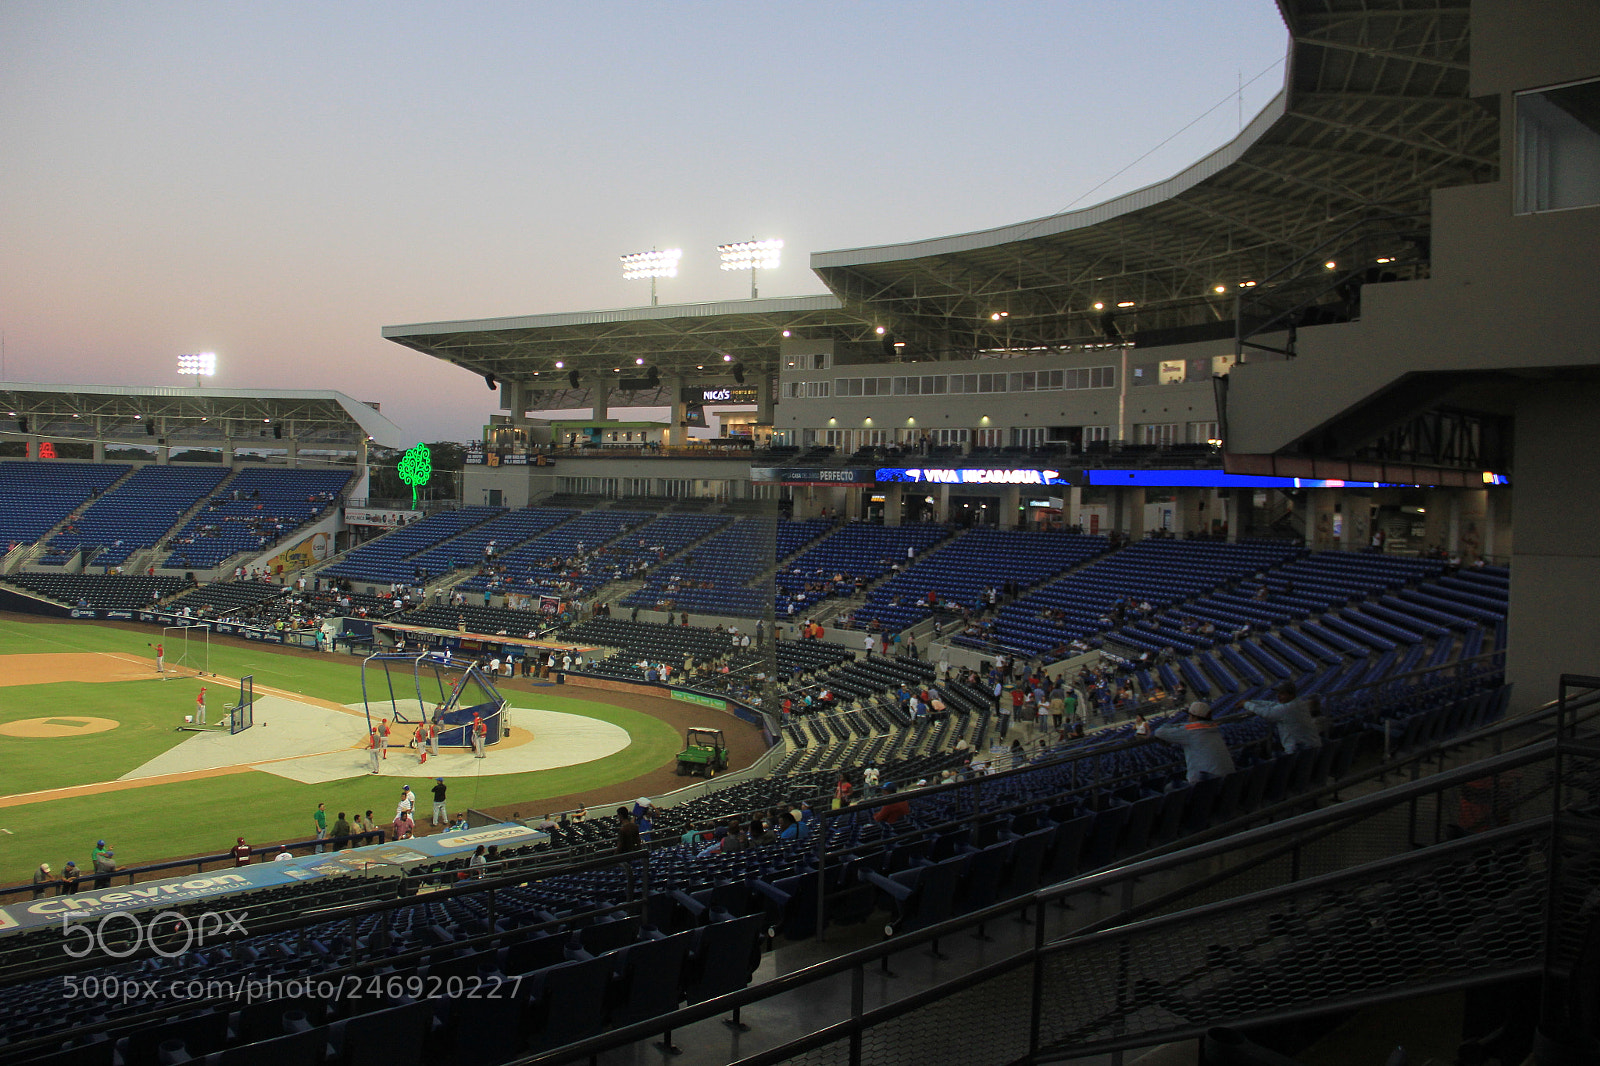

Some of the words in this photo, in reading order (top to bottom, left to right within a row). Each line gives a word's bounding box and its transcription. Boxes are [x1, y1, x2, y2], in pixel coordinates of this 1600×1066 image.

[703, 389, 730, 400] NICA'S
[820, 471, 853, 480] PERFECTO
[924, 469, 959, 483] VIVA
[962, 469, 1041, 483] NICARAGUA
[27, 873, 247, 914] Chevron
[45, 895, 172, 920] LUBRICANTES
[177, 881, 253, 898] PREMIUM
